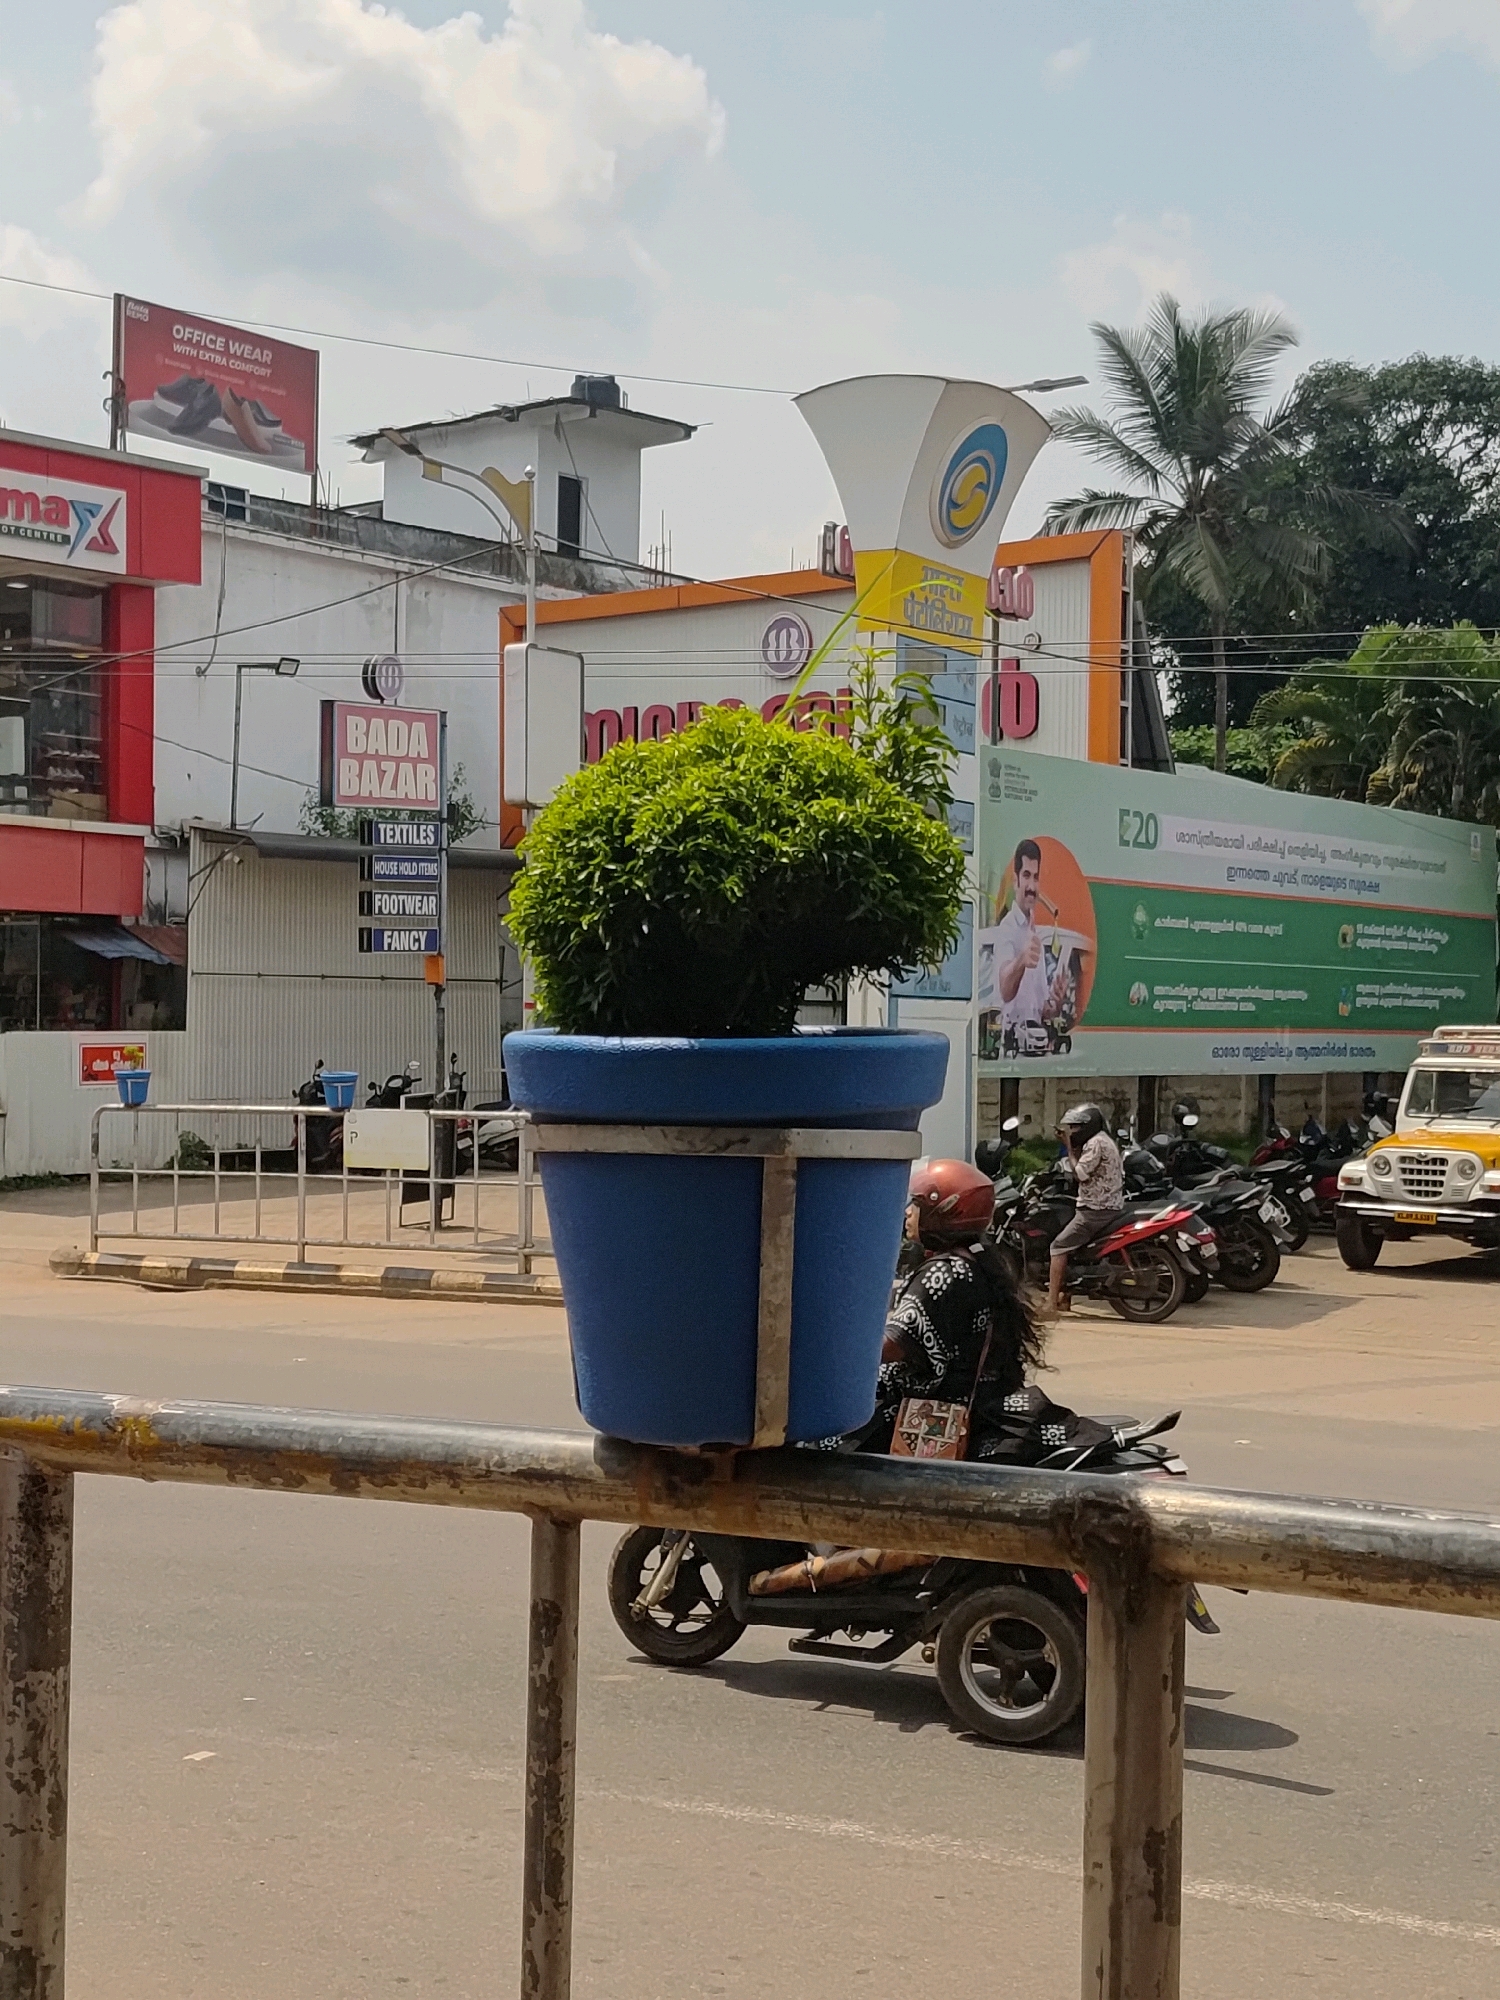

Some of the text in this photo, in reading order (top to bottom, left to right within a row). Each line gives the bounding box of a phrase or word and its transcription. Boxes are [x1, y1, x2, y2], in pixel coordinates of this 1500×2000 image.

[172, 324, 273, 365] OFFICE WEAR
[173, 343, 198, 358] WITH
[199, 350, 227, 367] EXTRA
[228, 359, 273, 378] COMFORT
[19, 528, 63, 543] CENTRE
[346, 715, 429, 759] BADA
[339, 758, 436, 802] BAZAR
[377, 822, 436, 846] TEXTILES
[1118, 807, 1159, 850] E20
[374, 861, 438, 876] HOUSE HOLD ITEMS
[374, 894, 438, 916] FOOTWEAR
[383, 929, 428, 952] FANCY
